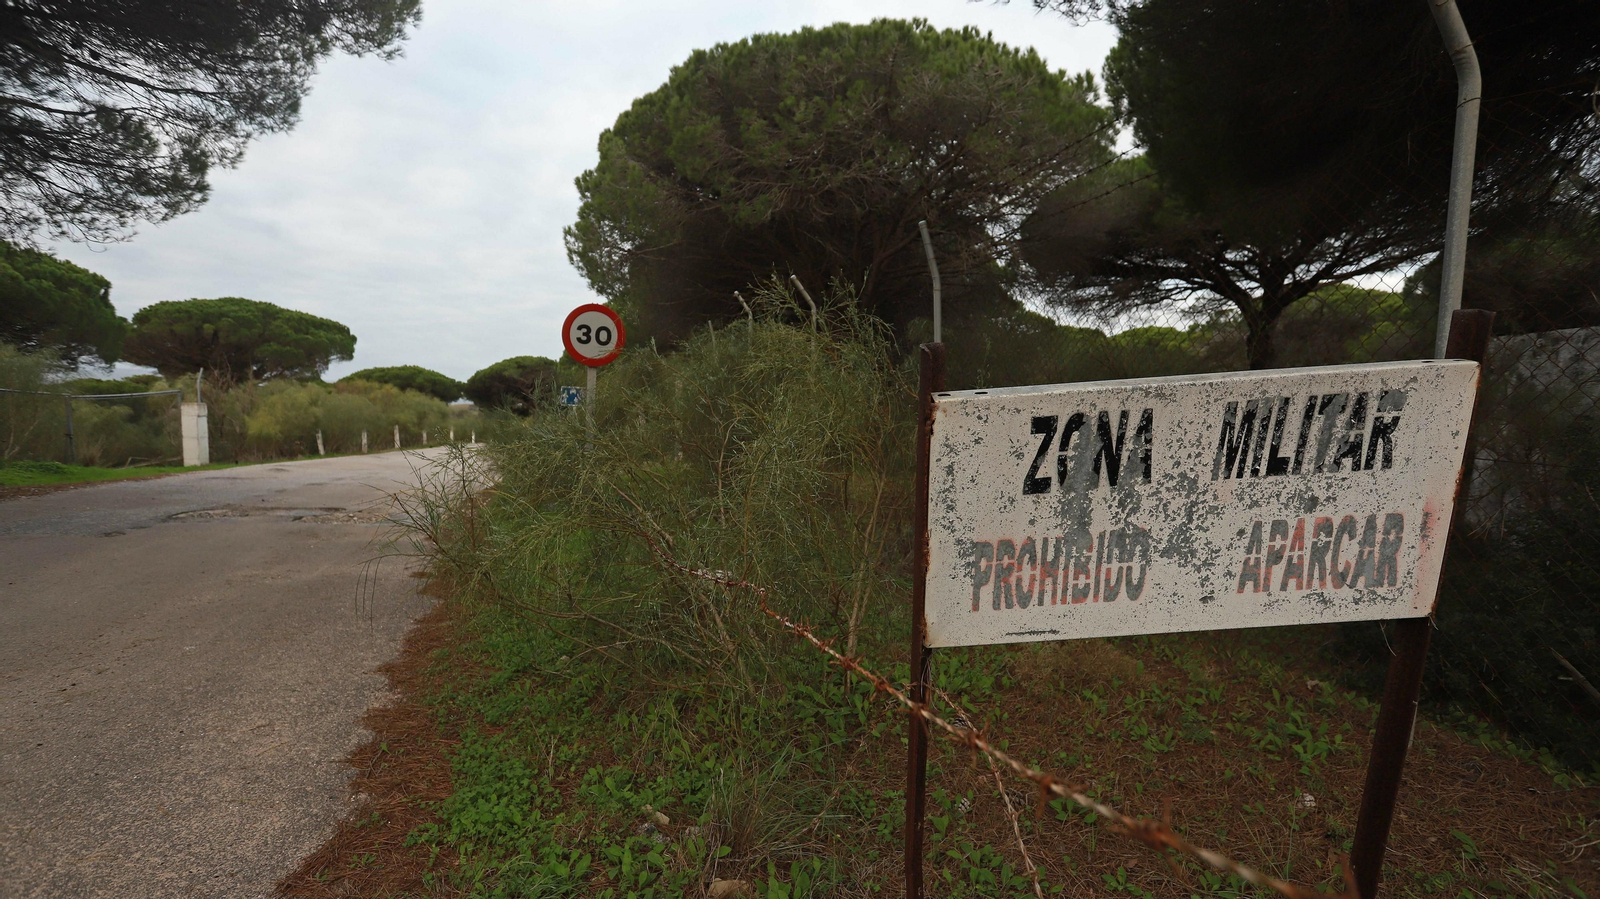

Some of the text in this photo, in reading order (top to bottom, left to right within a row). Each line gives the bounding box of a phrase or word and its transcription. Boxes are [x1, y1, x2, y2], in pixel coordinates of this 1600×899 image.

[576, 324, 612, 346] 30
[1022, 389, 1408, 495] ZONA MILITAR
[971, 512, 1405, 612] PROHIBIDO APARCAR
